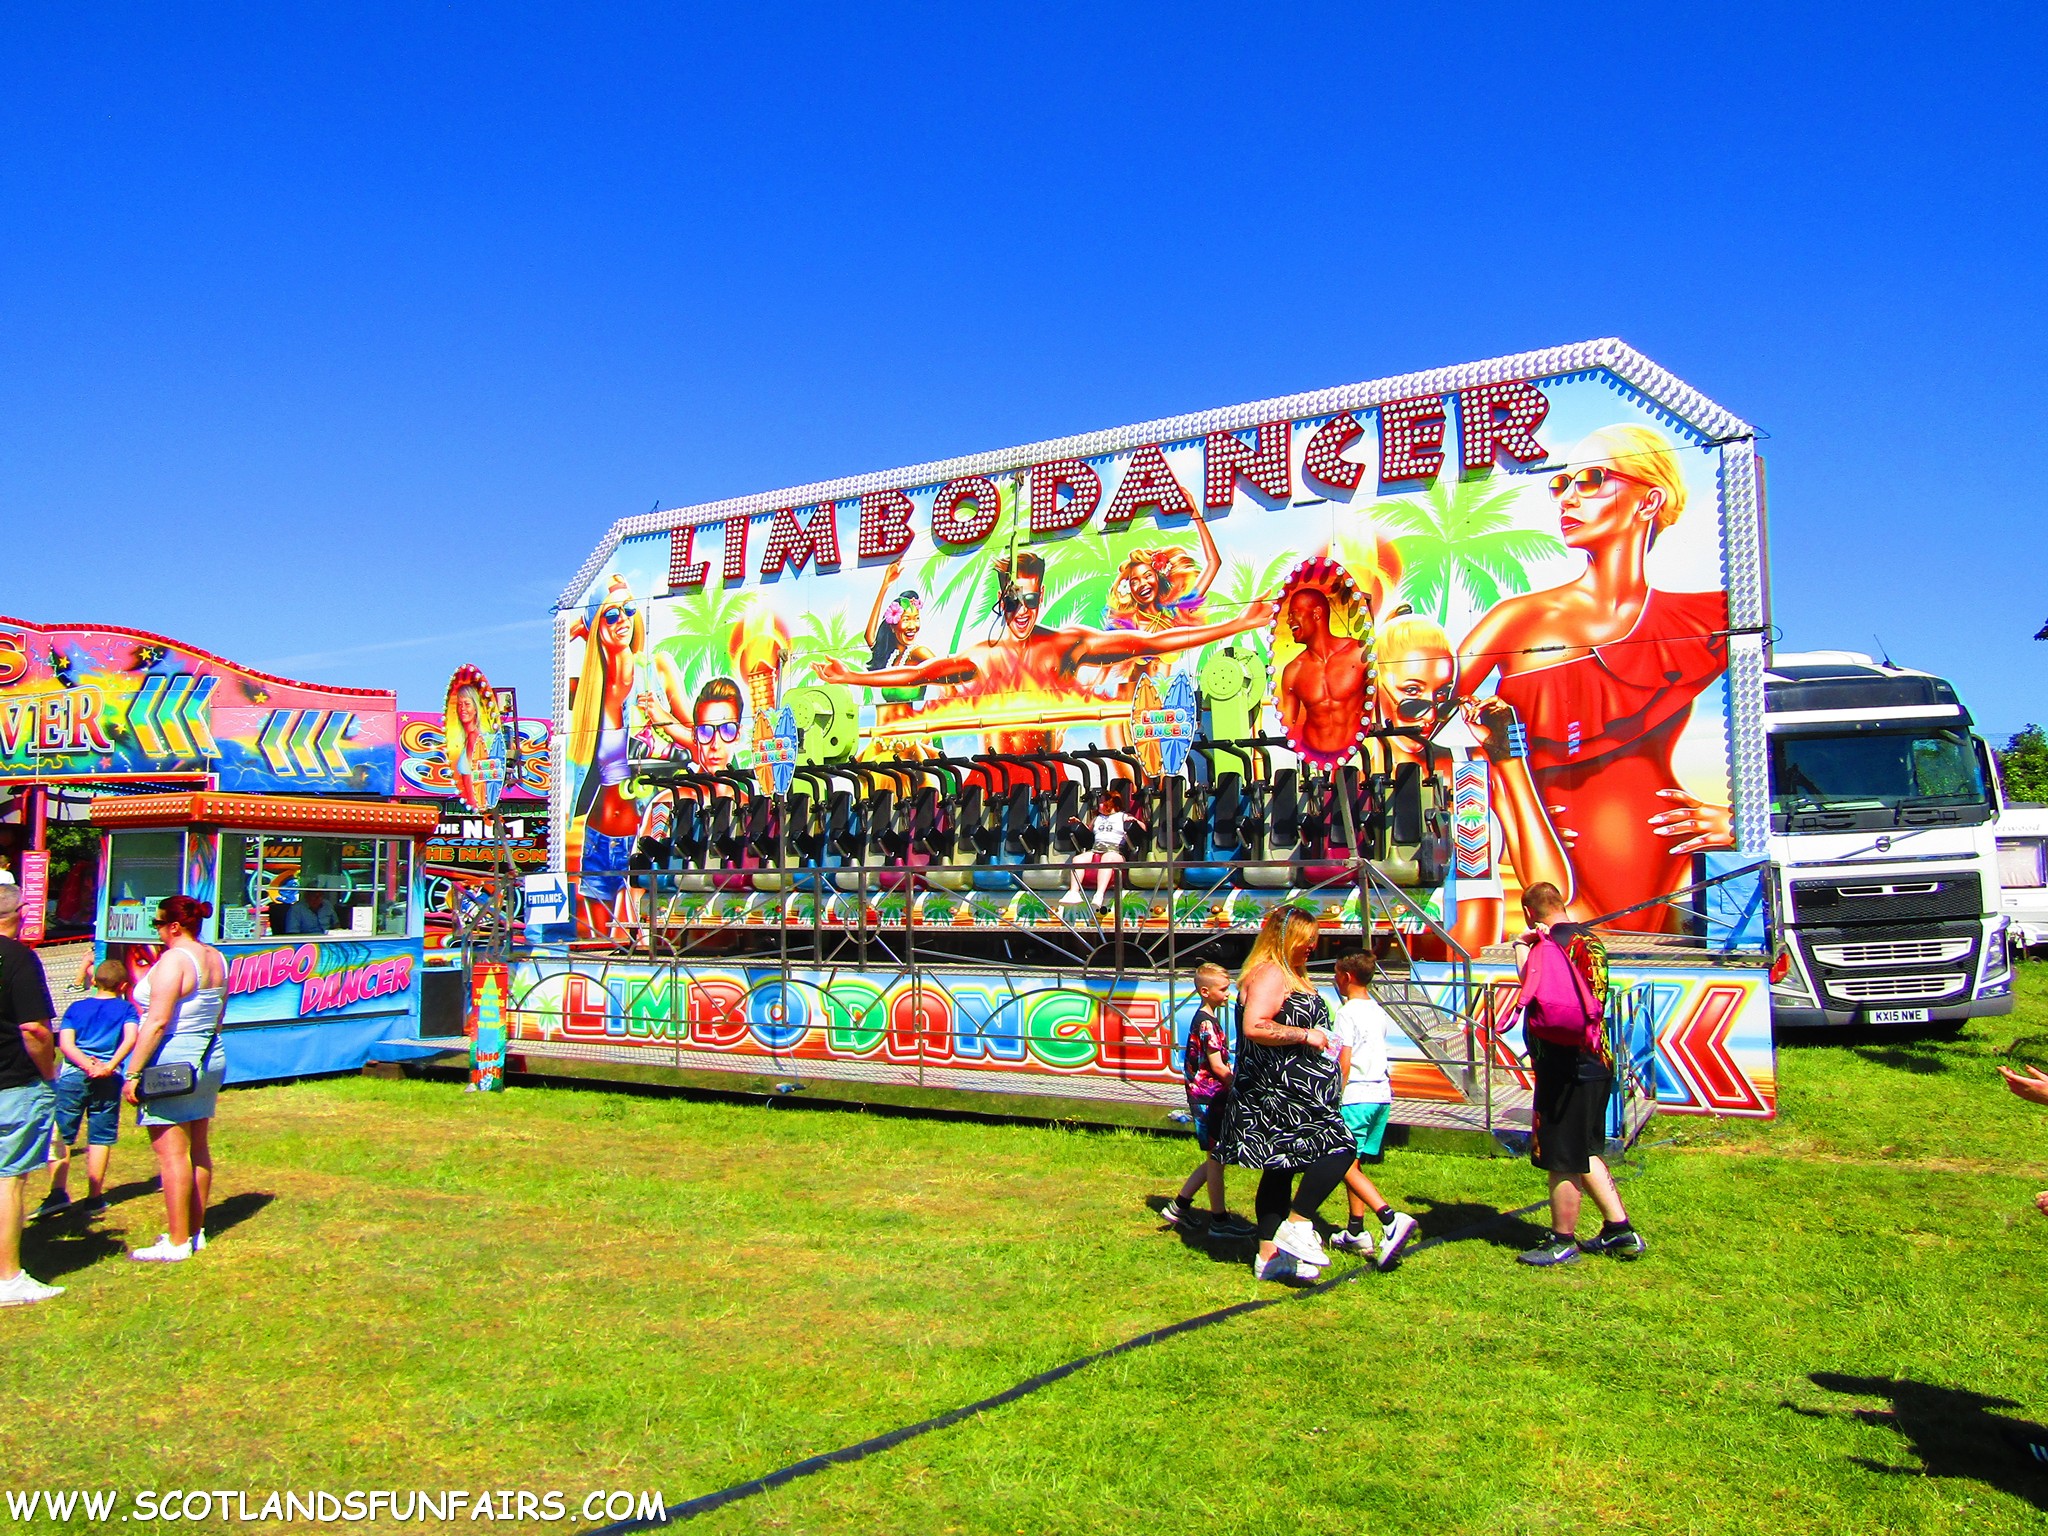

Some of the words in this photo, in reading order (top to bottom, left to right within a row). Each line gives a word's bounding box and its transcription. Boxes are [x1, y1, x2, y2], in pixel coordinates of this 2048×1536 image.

[668, 475, 1001, 588] LIMBO
[1030, 381, 1550, 534] DANCER
[1142, 710, 1186, 725] LIMBO
[1134, 724, 1193, 739] DANCER
[759, 737, 791, 752] LIMBO
[754, 748, 796, 764] DANCER
[426, 838, 535, 847] ACROSS
[425, 848, 455, 862] HE
[459, 848, 548, 863] NATON
[528, 893, 563, 904] ENTRANCE
[229, 943, 318, 995] IMBO
[301, 956, 413, 1015] DANCER
[562, 976, 813, 1050] LIMBO
[1875, 1011, 1899, 1022] KX15
[1901, 1010, 1922, 1021] NWE
